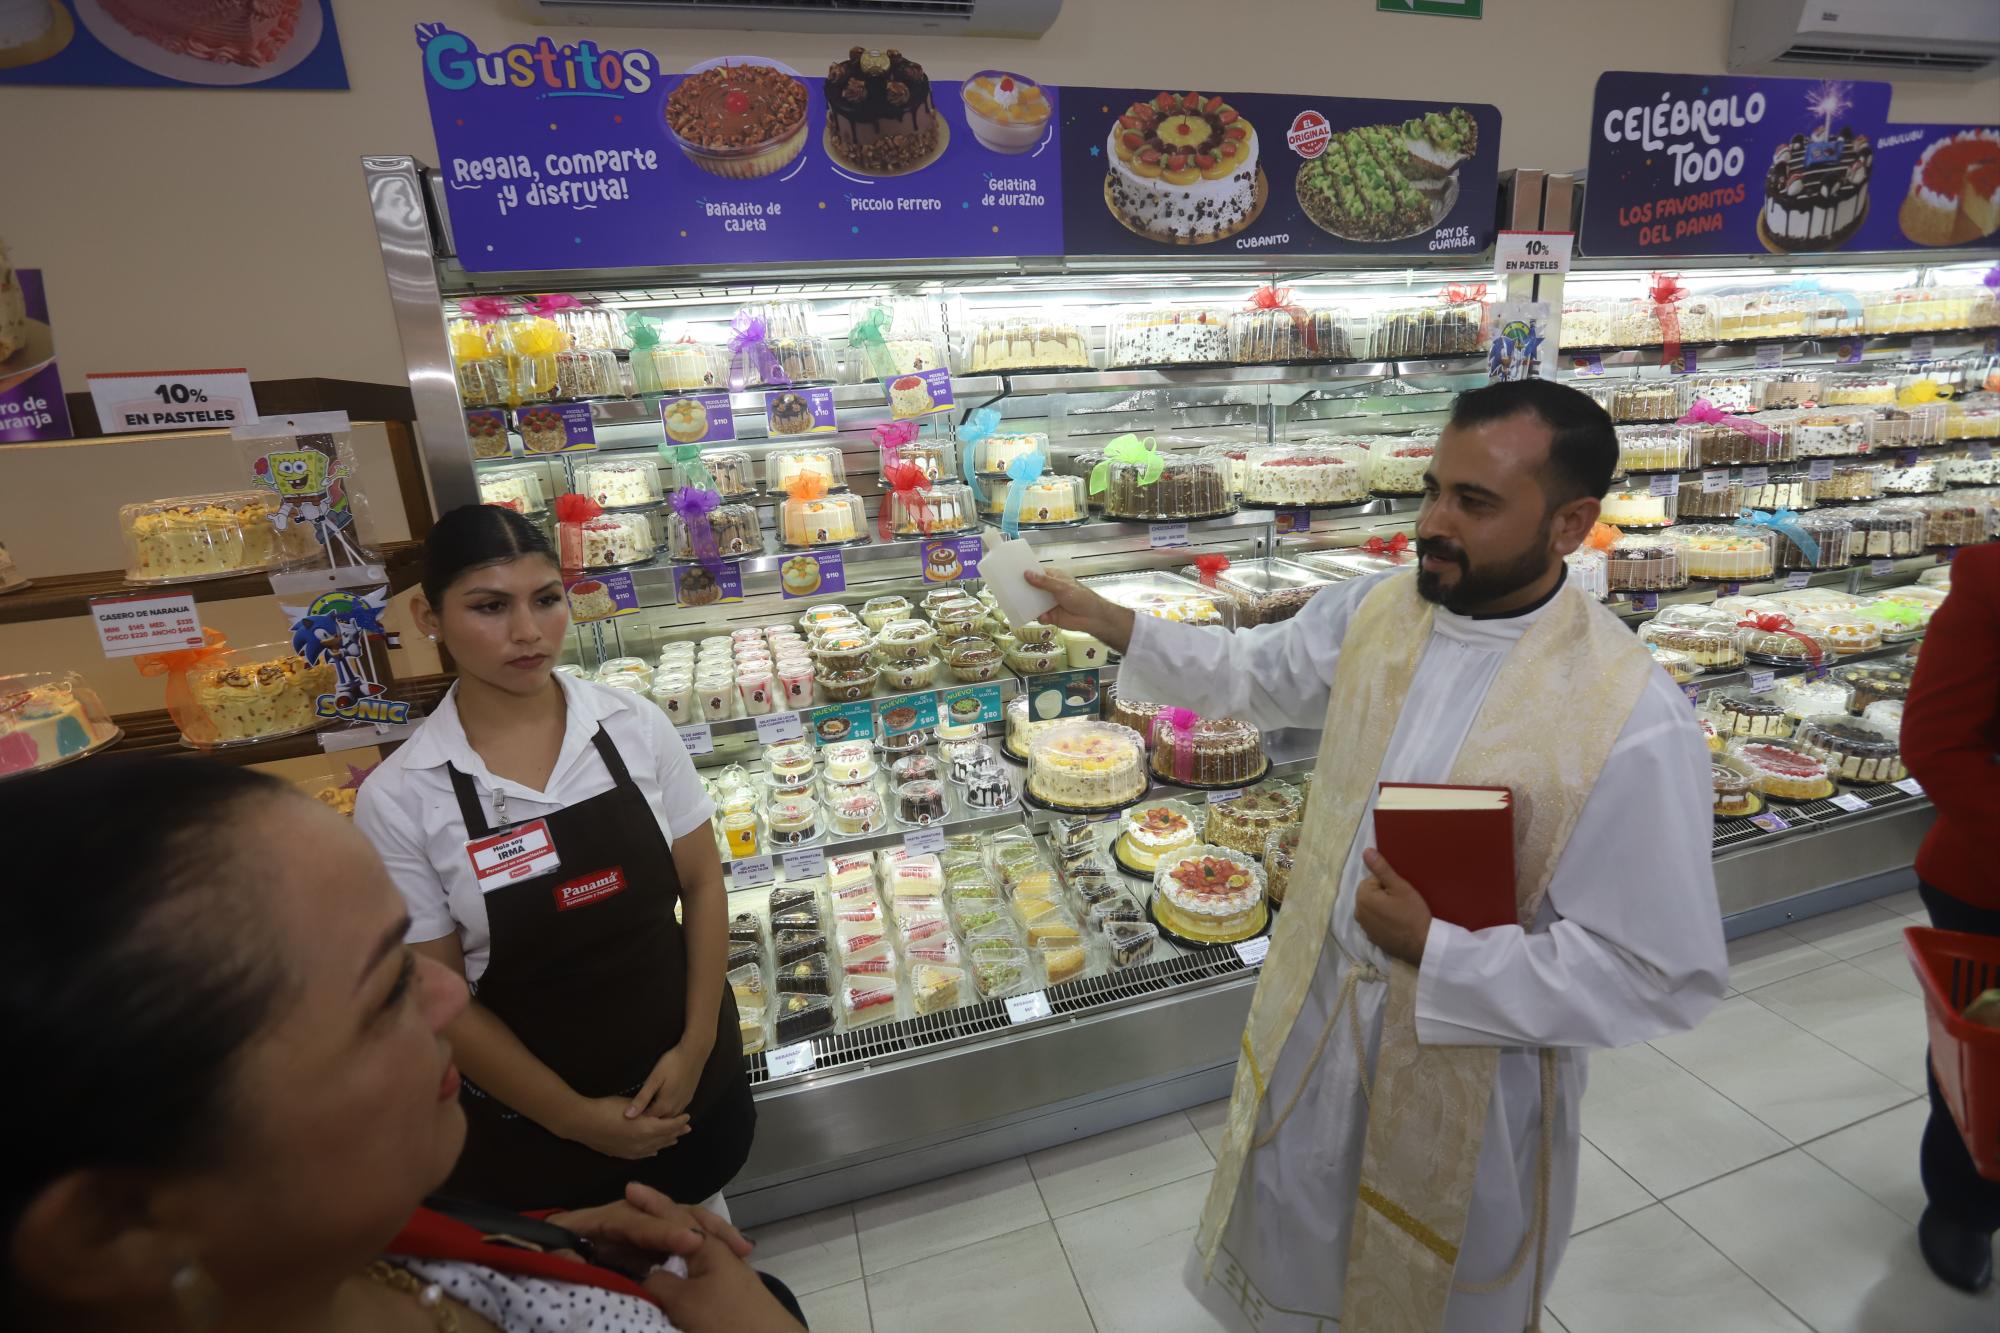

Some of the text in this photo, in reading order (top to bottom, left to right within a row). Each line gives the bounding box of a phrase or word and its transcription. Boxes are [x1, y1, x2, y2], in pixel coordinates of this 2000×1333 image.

[426, 33, 651, 93] Gustitos
[1302, 119, 1314, 129] EL
[1288, 126, 1330, 144] ORIGINAL
[453, 153, 540, 182] Regala,
[526, 177, 630, 207] disfruta!
[989, 178, 1037, 191] Gelatina
[851, 196, 942, 211] Piccolo Ferrero
[981, 192, 1045, 206] de durazno
[1619, 184, 1745, 227] LOS FAVORITOS
[706, 202, 782, 217] Bañadito de
[725, 218, 767, 233] cajeta
[1435, 225, 1469, 239] PAY DE
[1639, 213, 1723, 246] DEL PANA
[1236, 233, 1290, 249] CUBANITO
[1429, 235, 1476, 251] GUAYABA
[1525, 240, 1549, 256] 10%
[1506, 260, 1559, 270] EN PASTELES
[154, 383, 208, 405] 10%
[23, 396, 48, 412] de
[126, 409, 235, 426] EN PASTELES
[99, 611, 134, 621] CASERO
[150, 606, 190, 615] NARANJA
[493, 838, 523, 852] Hola soy
[498, 845, 526, 860] IRMA
[562, 872, 618, 899] Panamá
